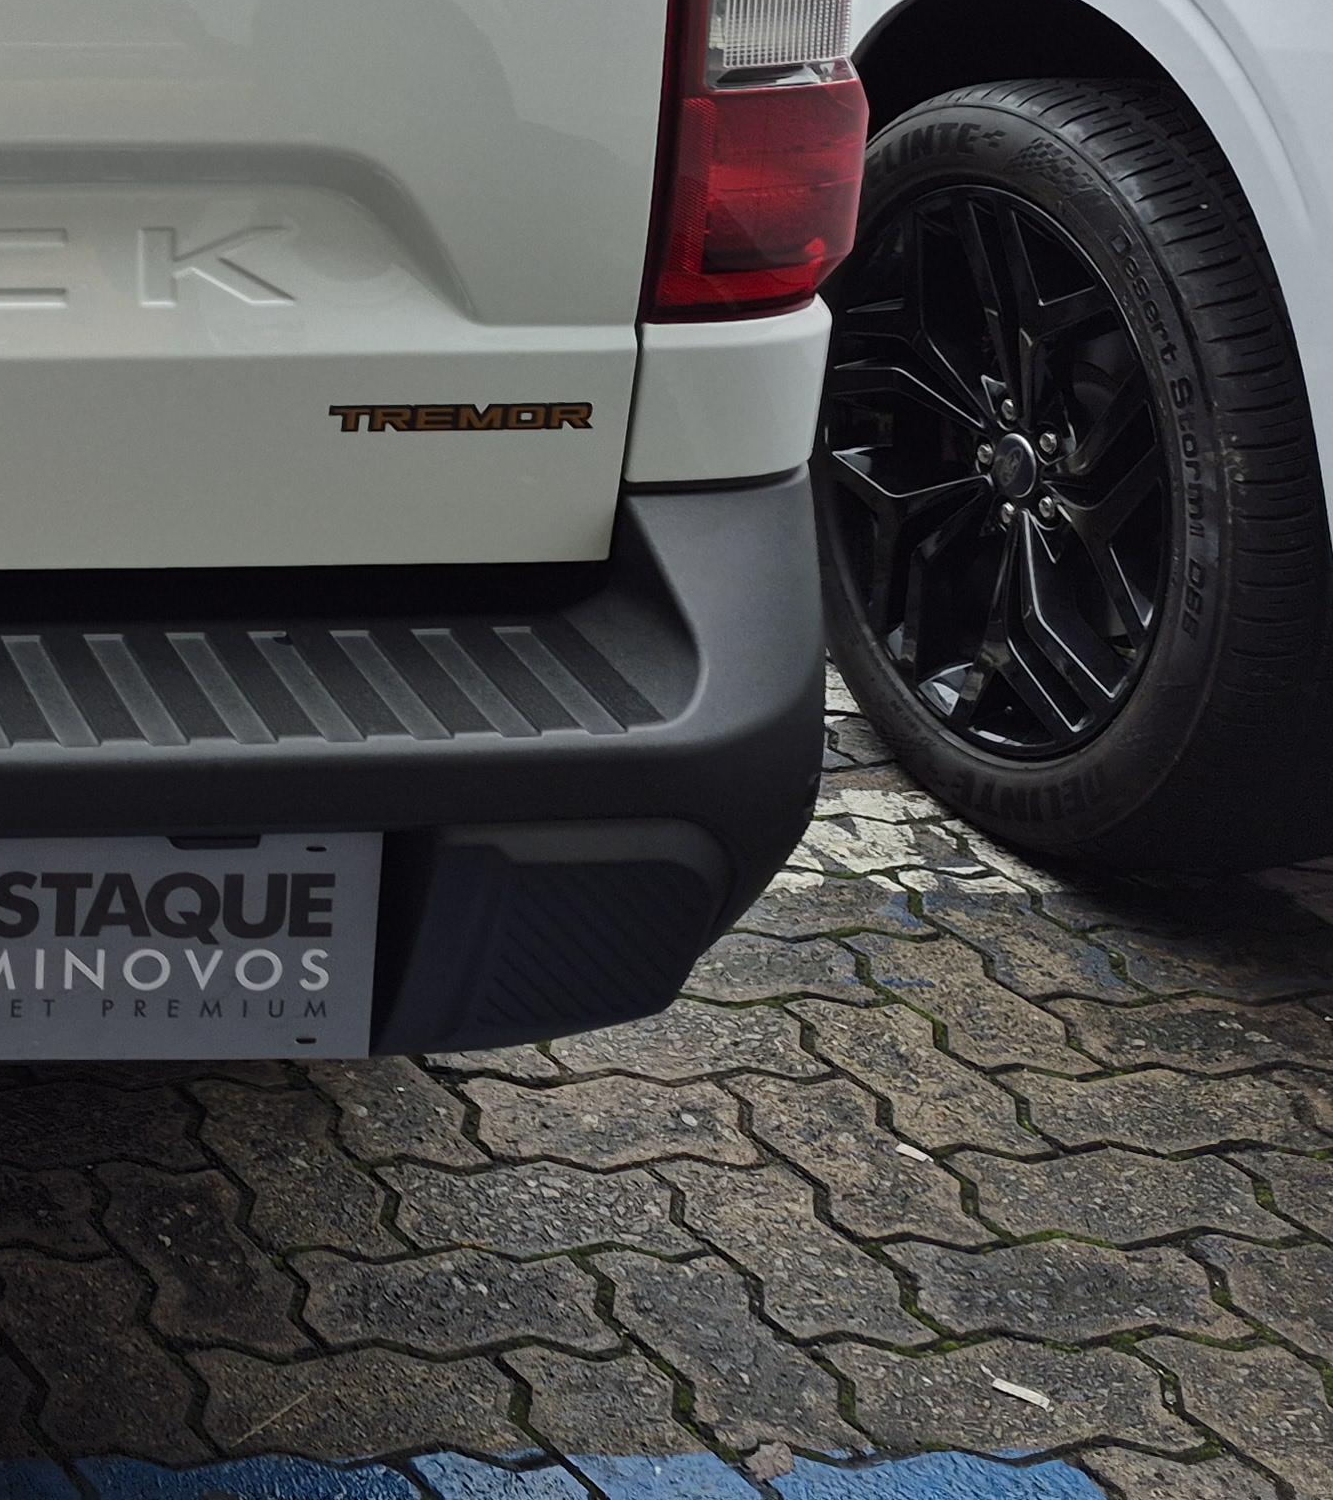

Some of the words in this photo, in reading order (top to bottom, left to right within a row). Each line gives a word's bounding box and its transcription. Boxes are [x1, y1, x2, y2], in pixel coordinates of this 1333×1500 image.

[865, 121, 982, 189] ELINTE
[329, 401, 594, 432] TREMOR
[101, 998, 329, 1020] PREMIUM
